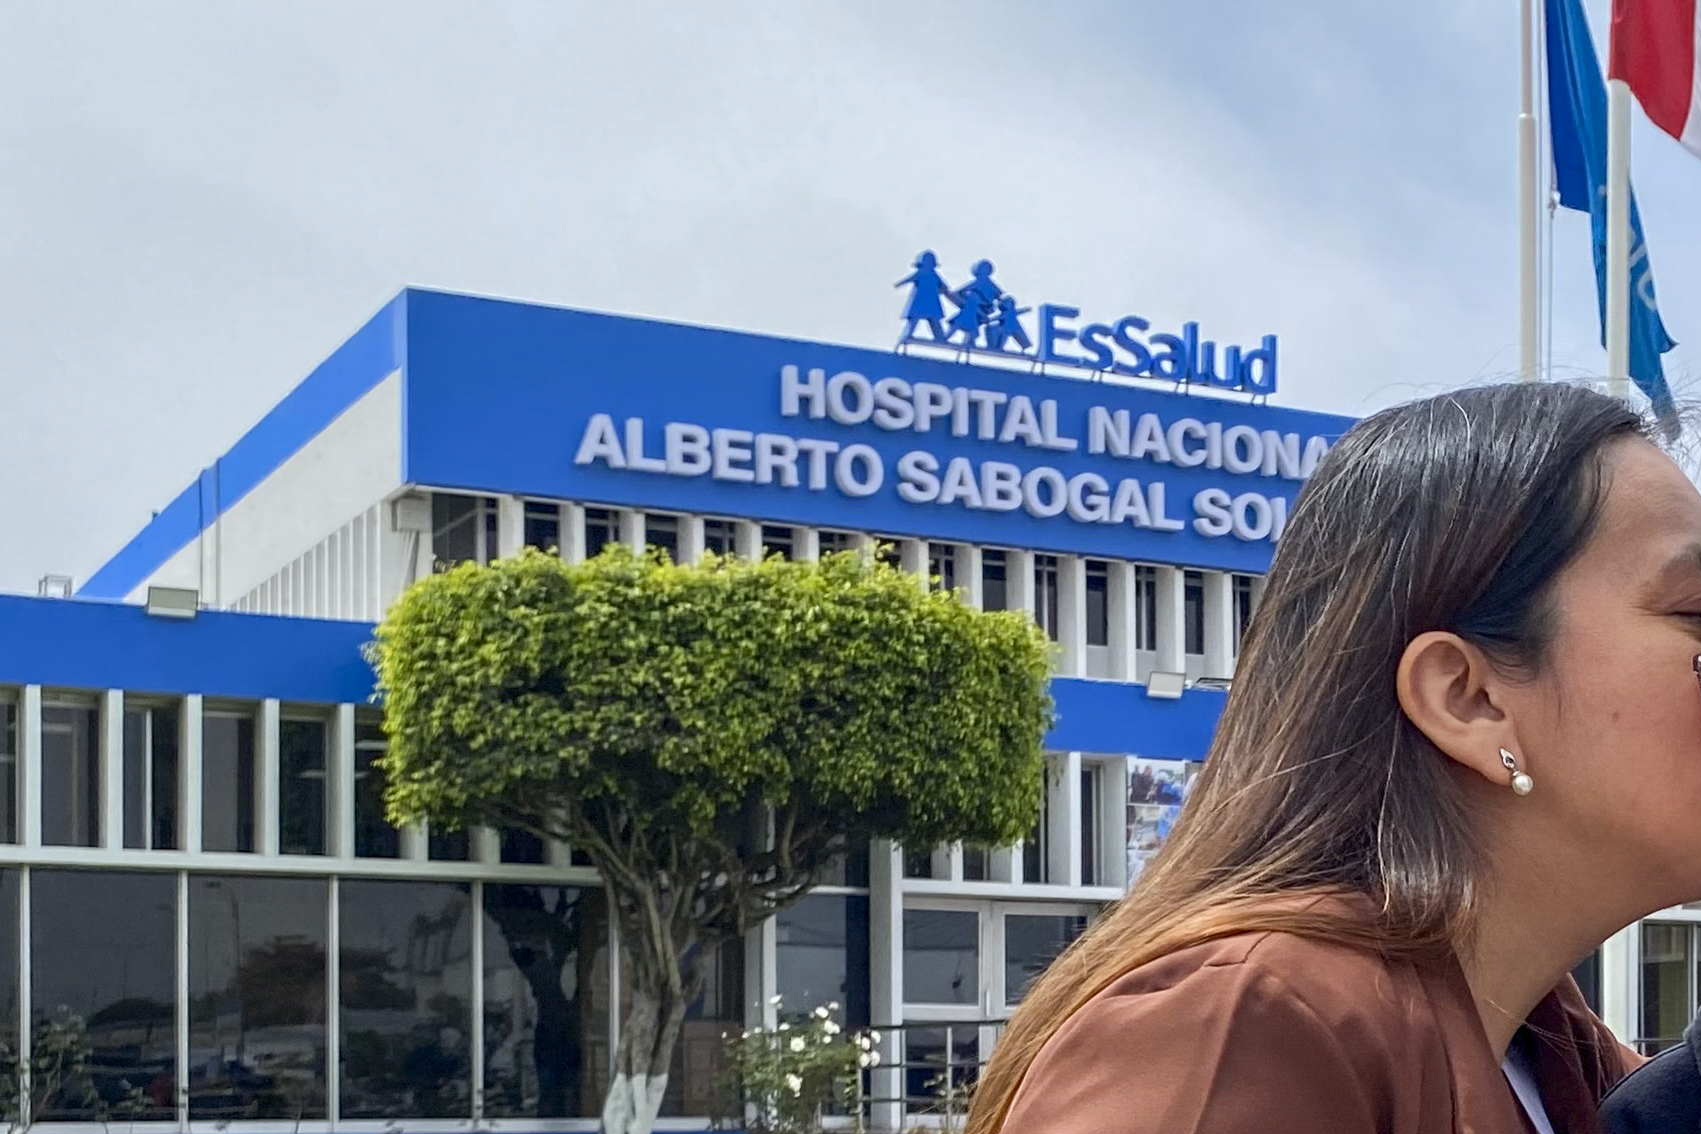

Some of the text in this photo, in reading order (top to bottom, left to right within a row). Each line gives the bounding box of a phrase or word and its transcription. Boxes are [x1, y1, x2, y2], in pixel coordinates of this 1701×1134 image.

[1040, 304, 1278, 394] EsSalud
[575, 414, 884, 497] ALBERTO
[897, 450, 1185, 532] SABOGAL
[779, 365, 1328, 480] HOSPITAL NACIONA
